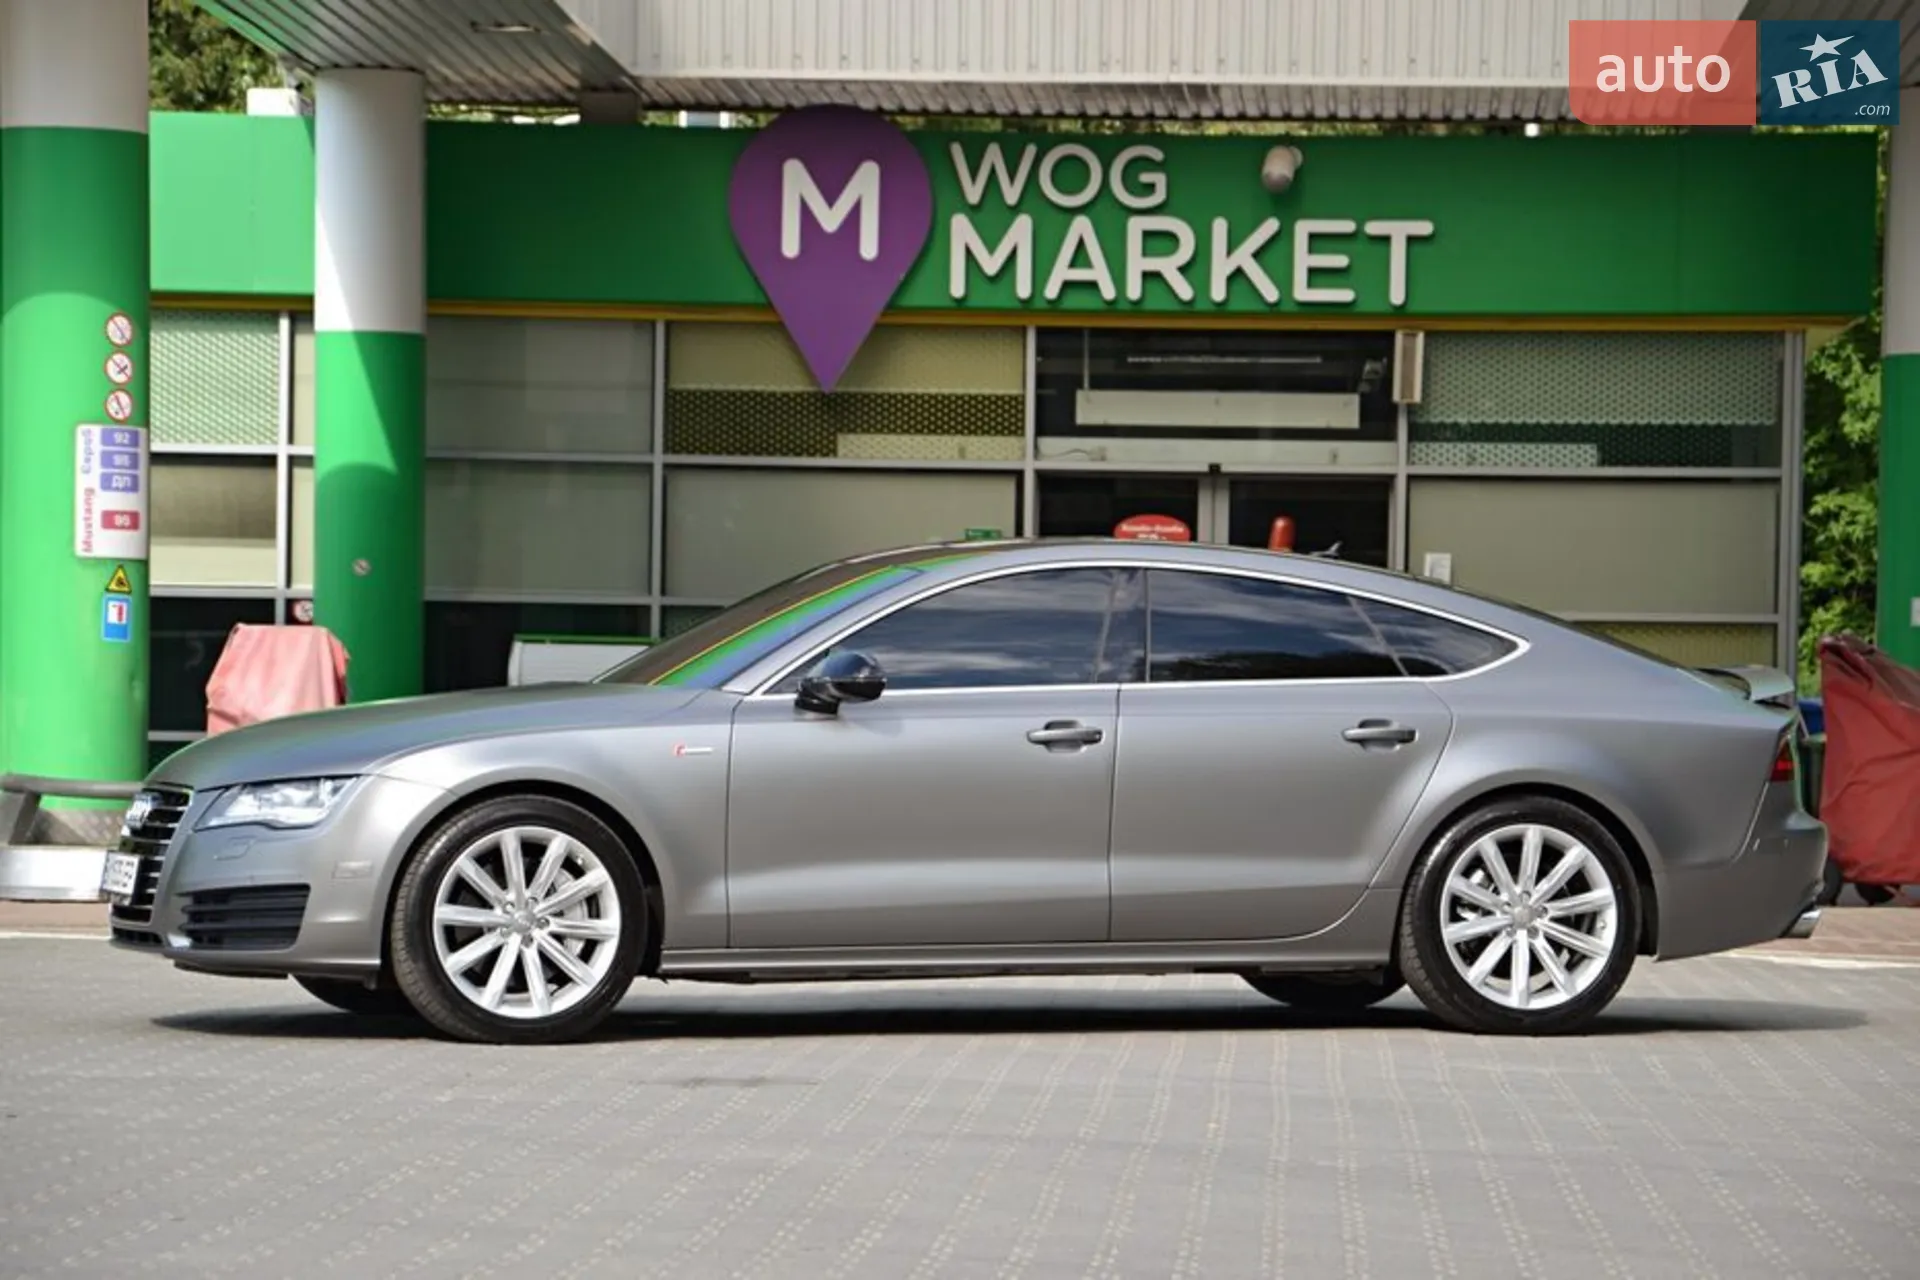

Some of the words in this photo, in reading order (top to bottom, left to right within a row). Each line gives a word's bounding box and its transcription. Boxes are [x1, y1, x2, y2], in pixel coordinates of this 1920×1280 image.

[781, 158, 881, 261] M
[949, 142, 1168, 209] WOG
[949, 213, 1434, 306] MARKET
